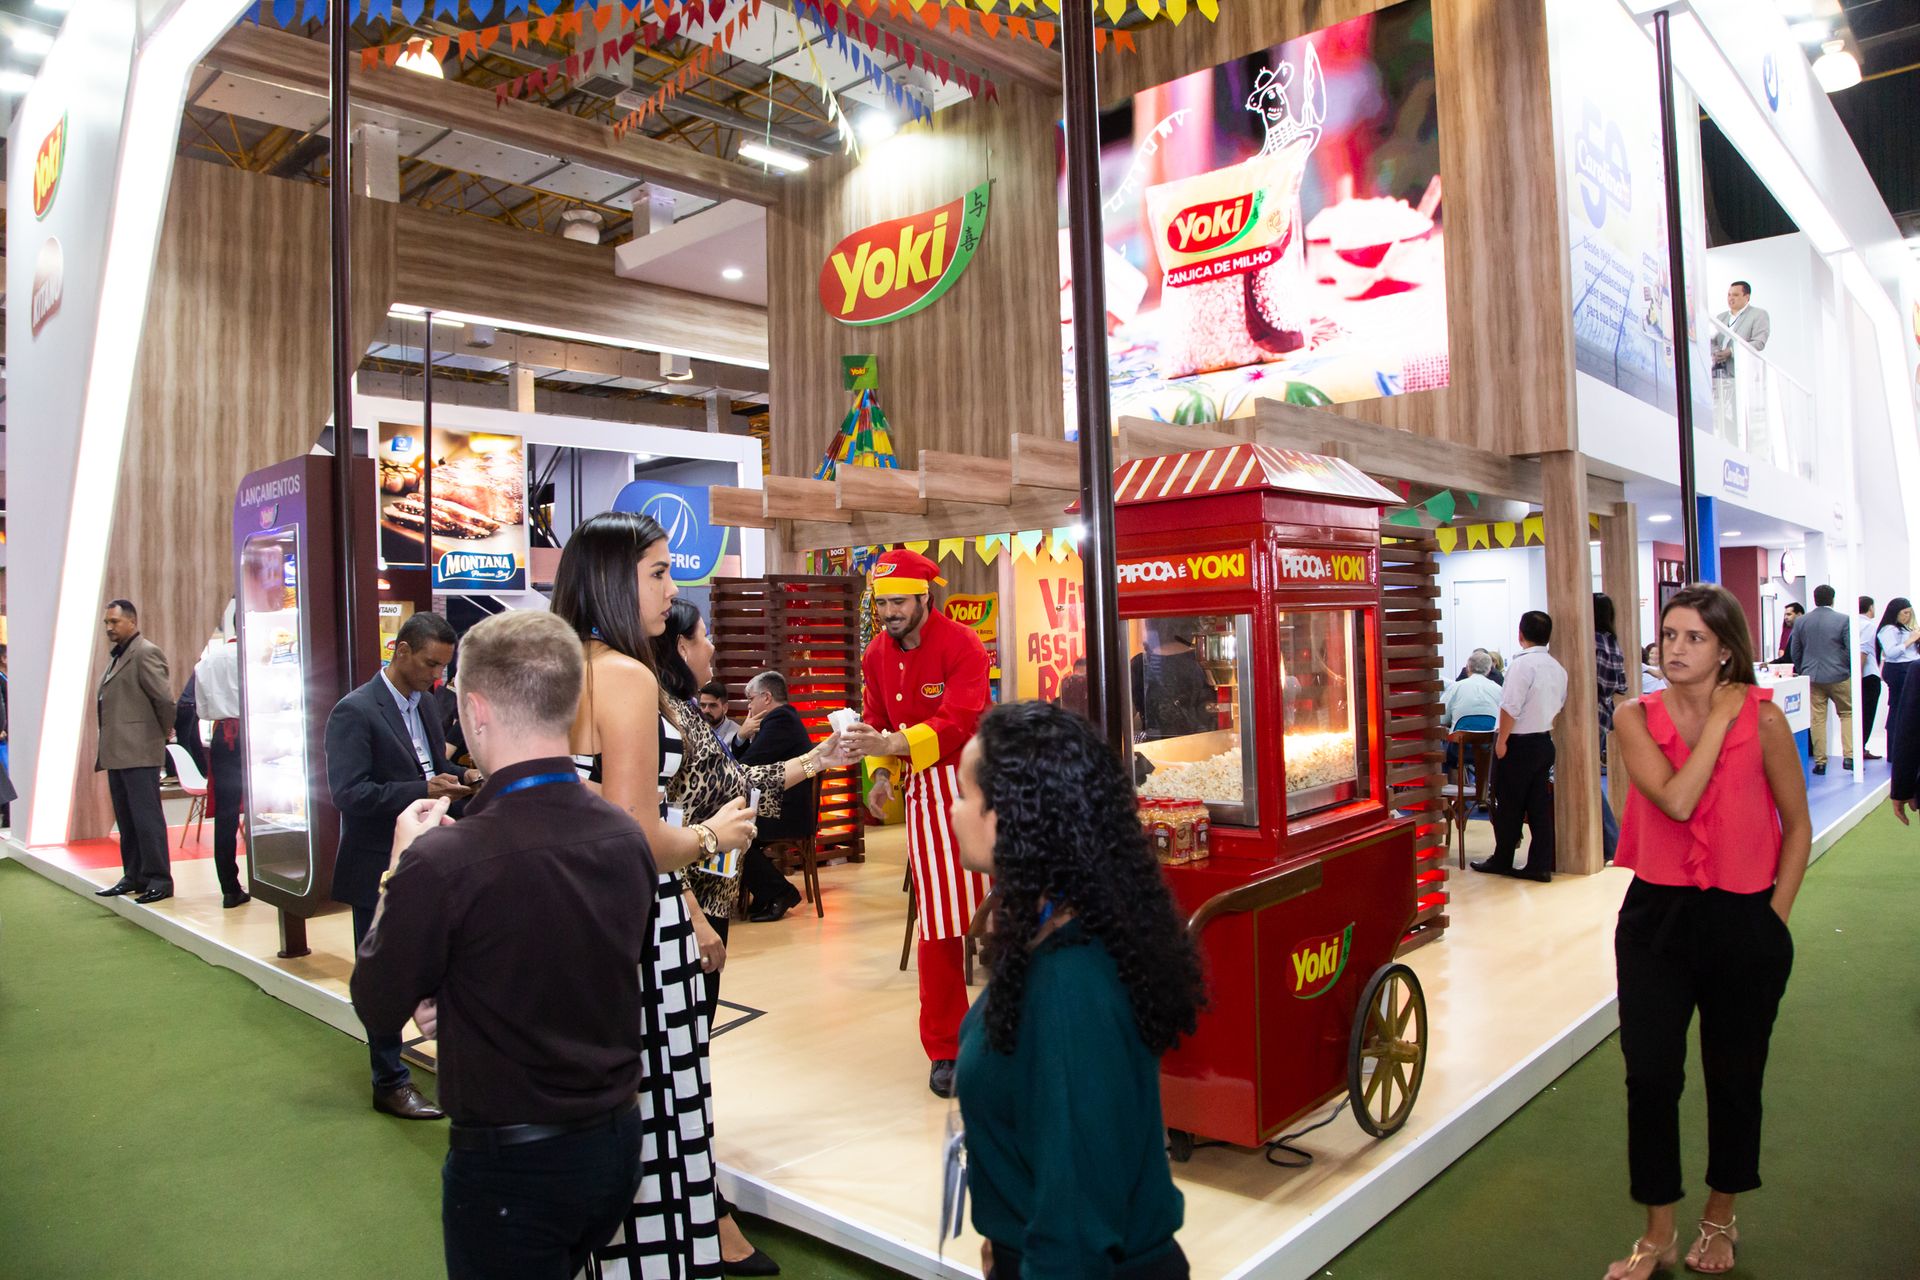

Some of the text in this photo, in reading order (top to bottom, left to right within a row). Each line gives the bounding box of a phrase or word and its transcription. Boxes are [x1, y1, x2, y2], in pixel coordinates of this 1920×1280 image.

[36, 124, 62, 211] Yoki
[1175, 199, 1244, 250] Yoki
[831, 211, 948, 315] Yoki
[1168, 250, 1272, 285] CANJICA DE MILHO
[851, 368, 866, 376] Yoki
[240, 474, 300, 507] LANÇAMENTOS
[445, 554, 510, 576] MONTANA
[669, 554, 700, 569] FRIG
[1116, 553, 1245, 584] PIPOCA É YOKI
[1282, 554, 1365, 581] PIPOCA É YOKI
[379, 606, 398, 614] TANO
[949, 602, 983, 621] Yoki
[1028, 632, 1087, 671] ASSU
[924, 685, 940, 695] Yoki
[1292, 936, 1340, 992] Yoki
